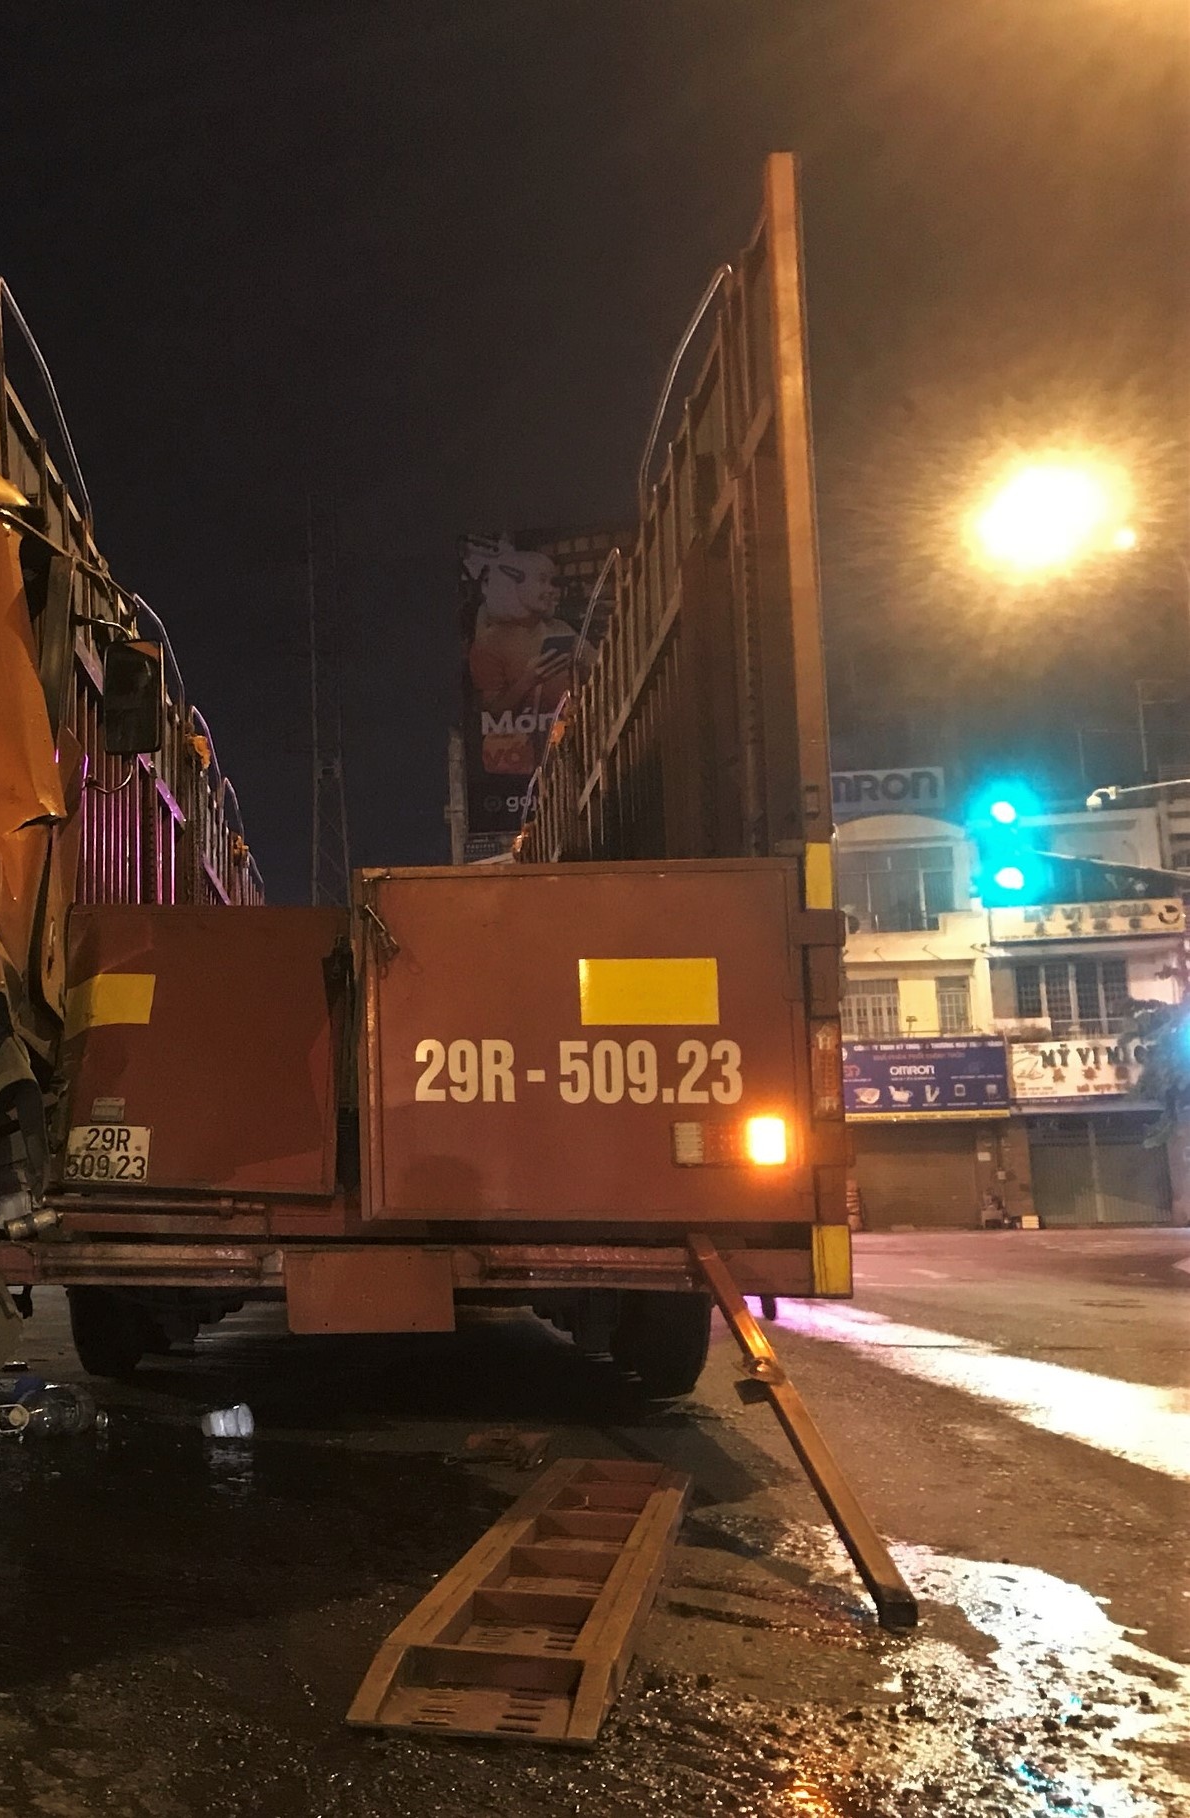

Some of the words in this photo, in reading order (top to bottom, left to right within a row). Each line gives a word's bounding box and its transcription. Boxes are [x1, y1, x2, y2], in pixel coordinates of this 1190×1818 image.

[831, 771, 938, 803] MRON
[415, 1038, 517, 1104] 29R
[527, 1069, 546, 1083] -
[558, 1039, 744, 1105] 509.23
[86, 1128, 131, 1153] 29R
[66, 1154, 146, 1181] 509.23
